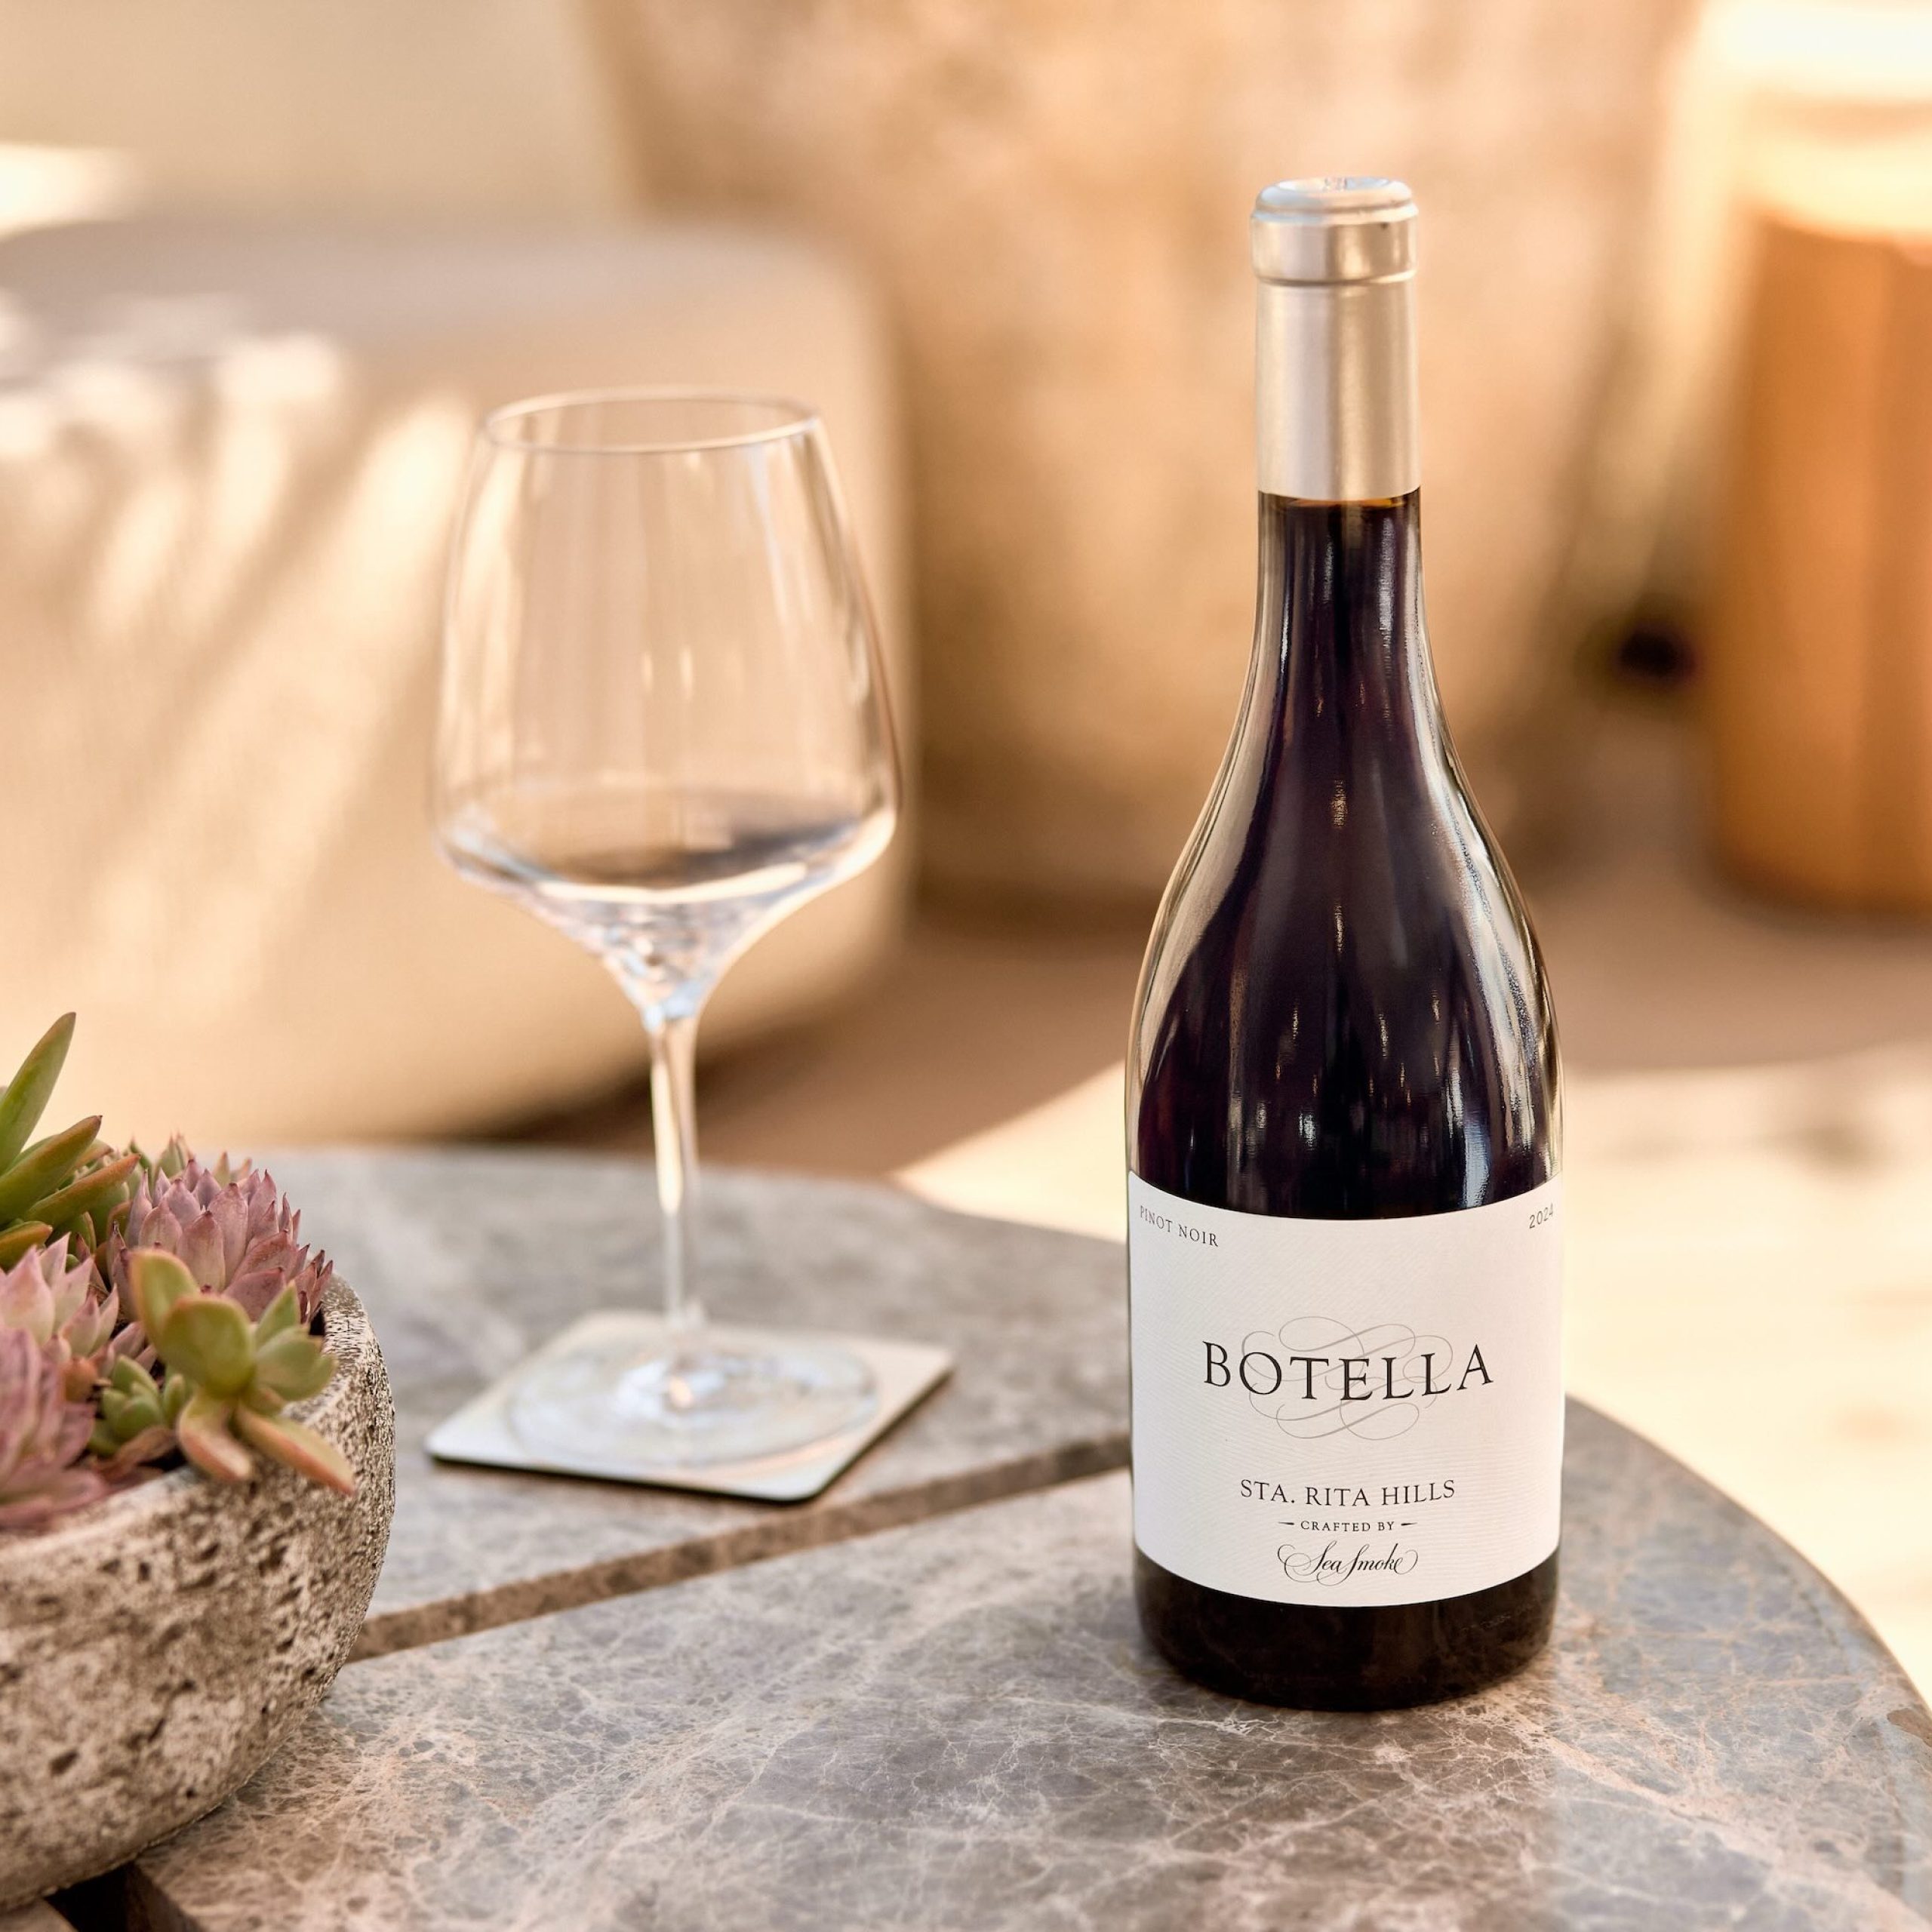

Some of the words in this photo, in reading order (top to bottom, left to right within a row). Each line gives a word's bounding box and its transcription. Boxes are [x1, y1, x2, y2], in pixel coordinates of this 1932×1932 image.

[1140, 1205, 1172, 1232] PINOT
[1178, 1224, 1219, 1247] NOIR
[1529, 1203, 1554, 1229] 2024
[1202, 1340, 1494, 1401] BOTELLA
[1240, 1478, 1295, 1504] STA.
[1305, 1486, 1371, 1507] RITA
[1381, 1479, 1455, 1506] HILLS
[1300, 1520, 1371, 1532] CRAFTED
[1377, 1521, 1395, 1532] BY
[1277, 1540, 1342, 1583] Sea
[1317, 1542, 1419, 1586] Smoke
